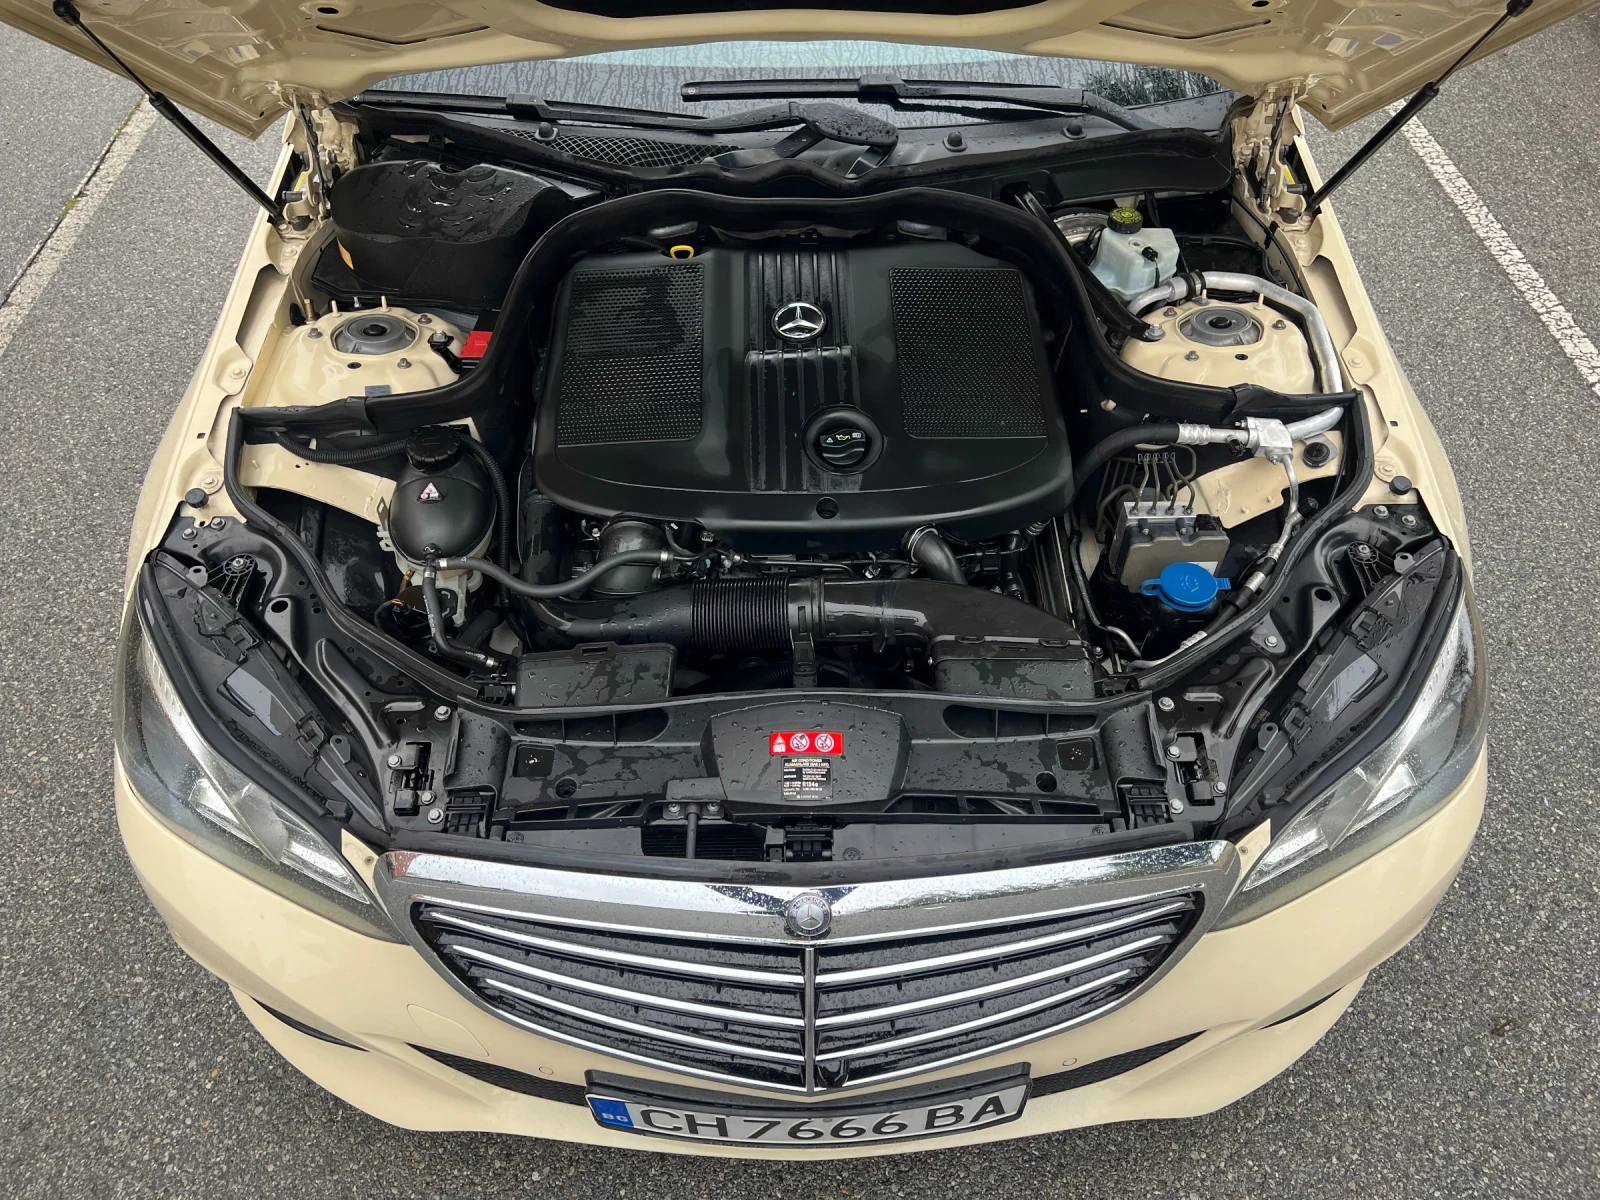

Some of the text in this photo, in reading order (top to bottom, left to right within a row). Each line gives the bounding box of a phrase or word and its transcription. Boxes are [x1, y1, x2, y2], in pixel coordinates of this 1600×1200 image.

[601, 1112, 629, 1123] BG
[640, 1095, 1007, 1140] CH 7666 BA
